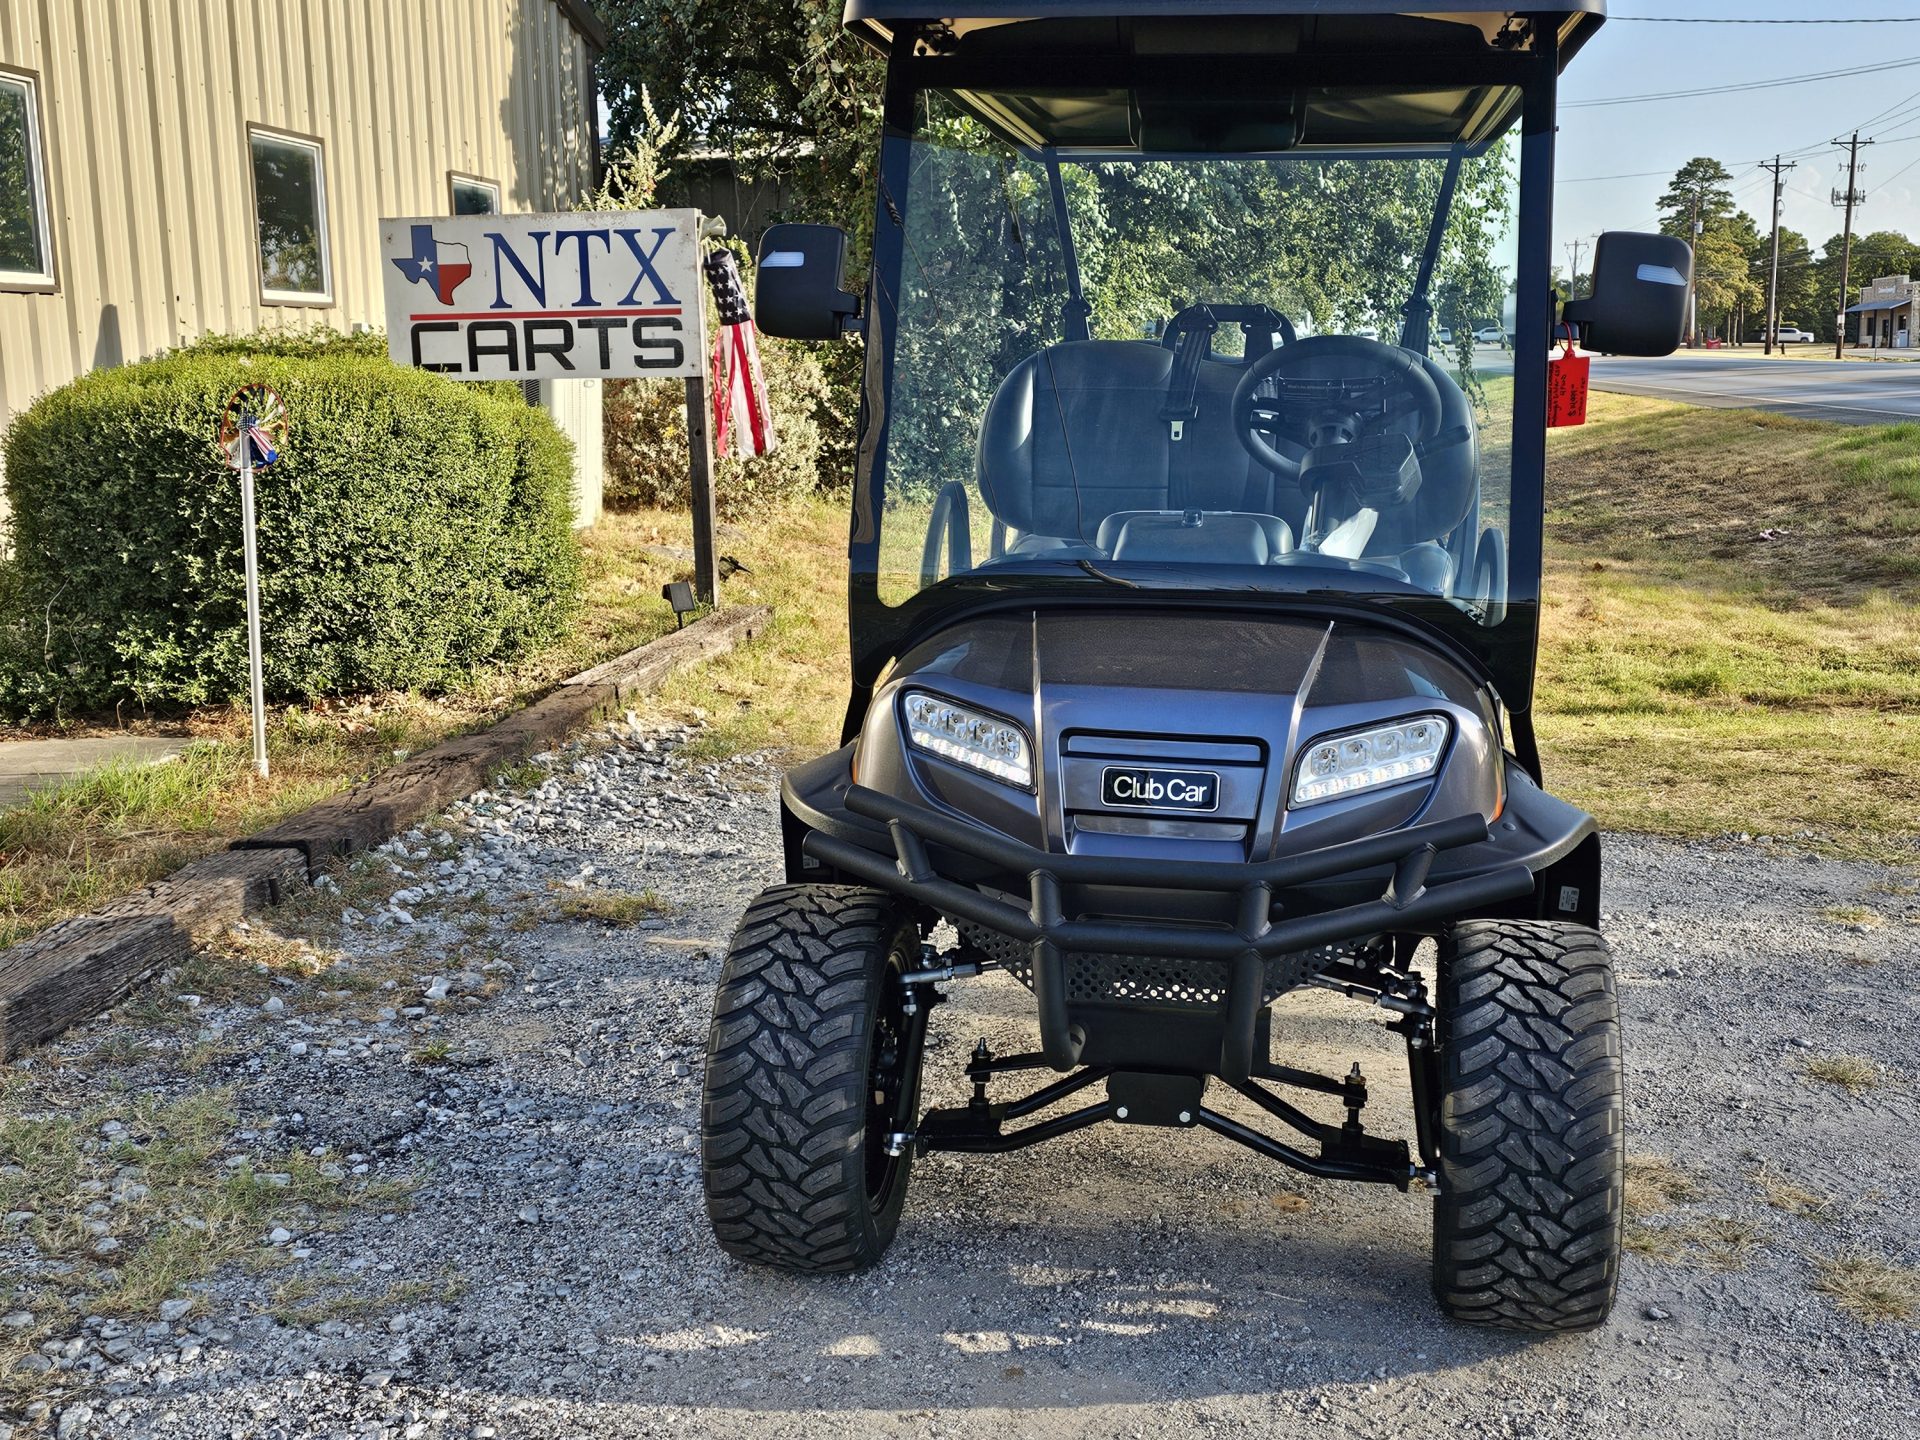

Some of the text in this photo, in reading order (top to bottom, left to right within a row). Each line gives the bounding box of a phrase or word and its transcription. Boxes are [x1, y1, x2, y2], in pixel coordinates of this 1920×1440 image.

[483, 227, 682, 309] NTX
[410, 317, 684, 372] CARTS
[1113, 775, 1208, 802] Club Car
